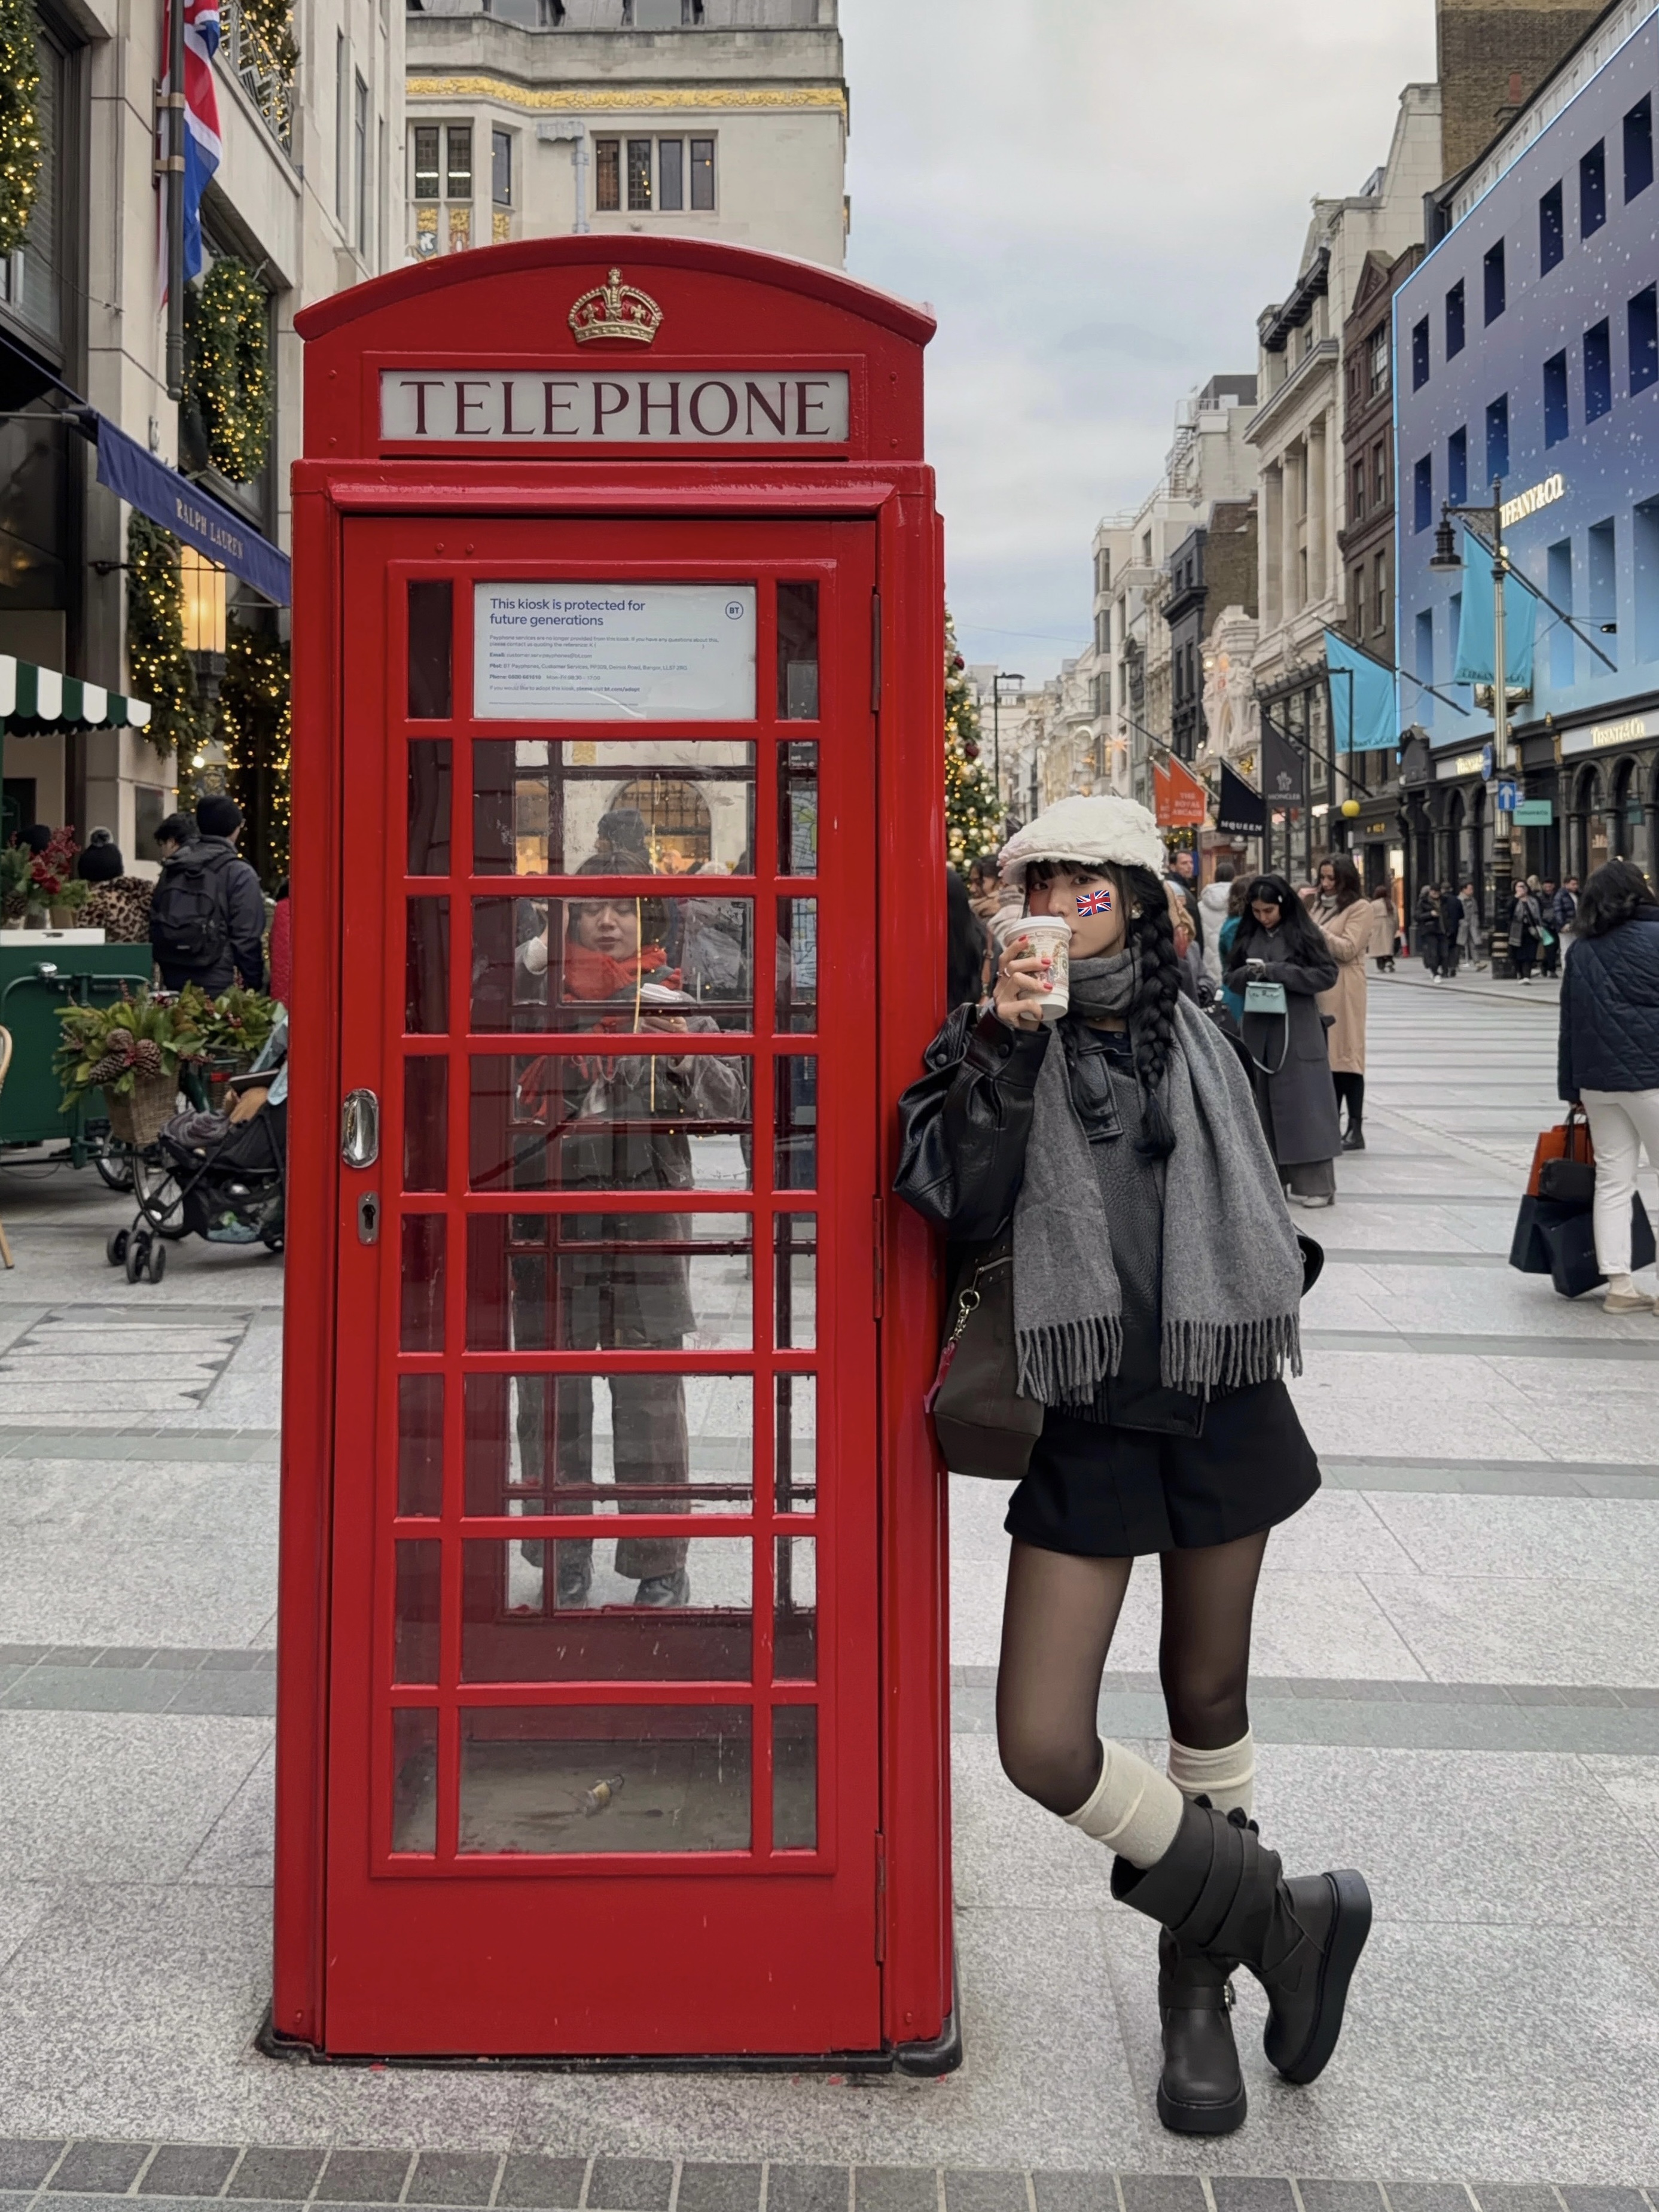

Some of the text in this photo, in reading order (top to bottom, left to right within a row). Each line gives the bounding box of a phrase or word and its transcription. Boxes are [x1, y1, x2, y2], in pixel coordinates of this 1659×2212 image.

[400, 380, 830, 436] TELEPHONE
[176, 498, 243, 559] RALPH LAUREN
[490, 598, 645, 612] This kiosk is protected for
[490, 614, 603, 627] future generations
[1172, 809, 1203, 817] ARCADE
